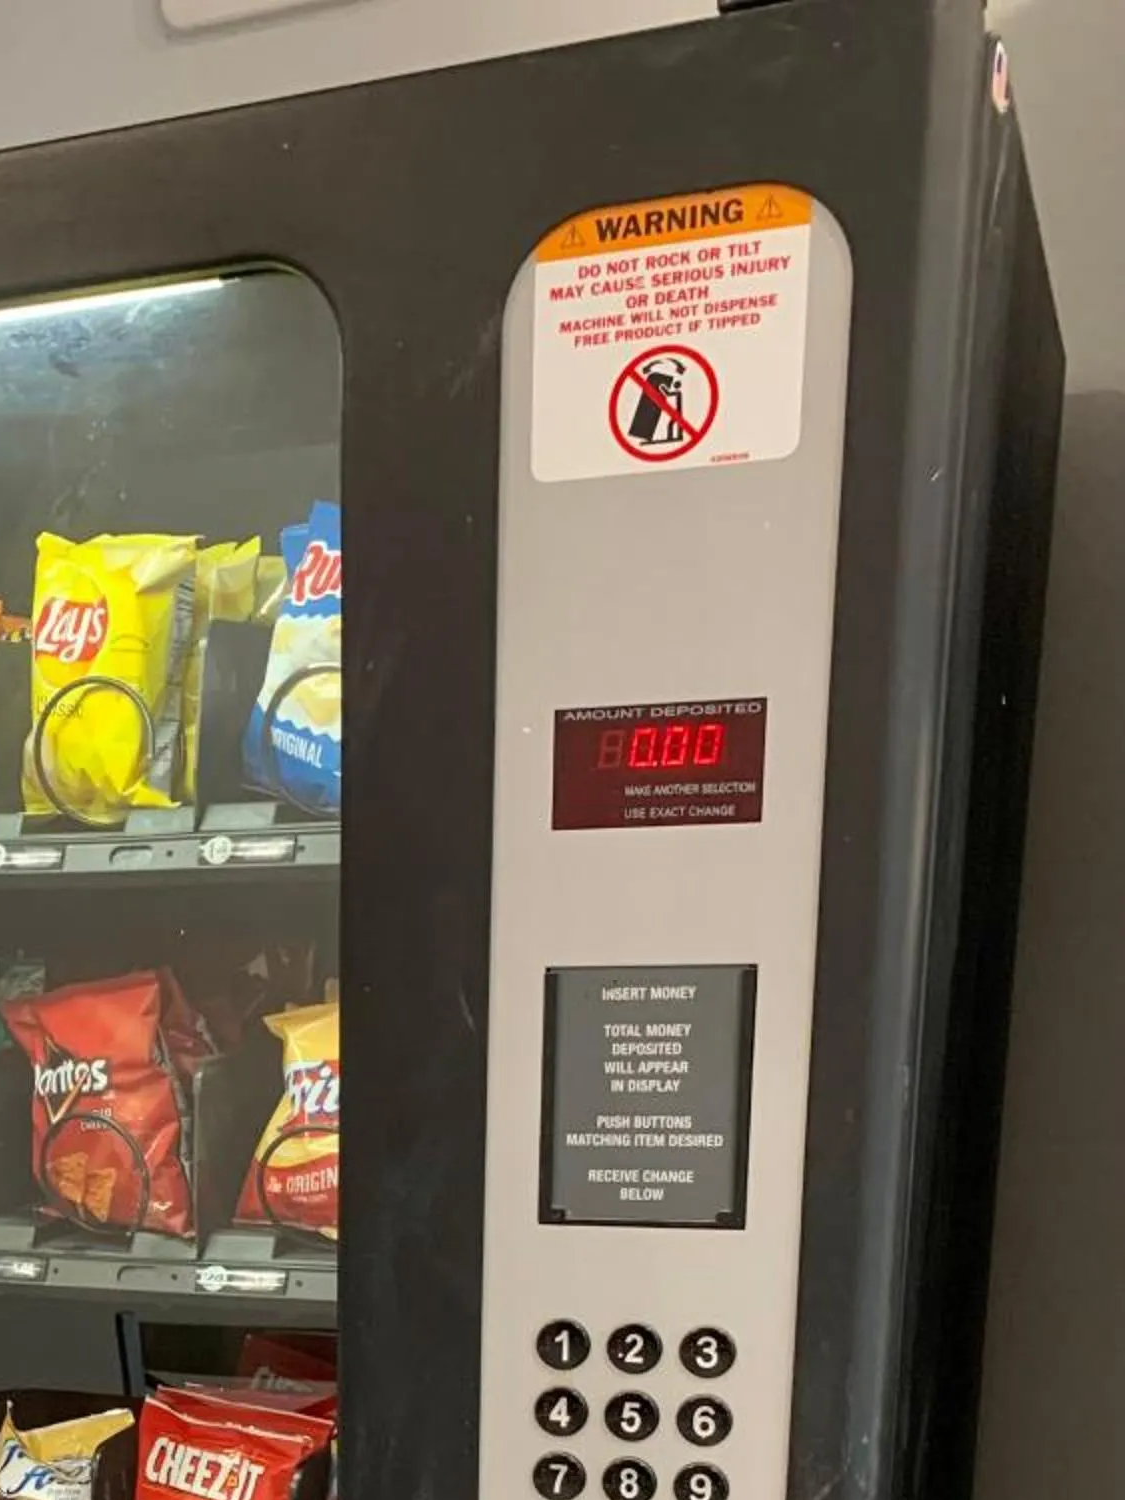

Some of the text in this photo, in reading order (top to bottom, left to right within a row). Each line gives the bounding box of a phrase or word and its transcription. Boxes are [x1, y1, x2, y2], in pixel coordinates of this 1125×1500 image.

[596, 200, 744, 243] WARNING
[578, 241, 762, 280] DO NOT ROCK OR TILT
[549, 256, 792, 302] MAY CAUSE SERIOUS INJURY
[625, 286, 709, 309] OR DEATH
[559, 293, 779, 334] MACHINE WILL NOT DISPENSE
[573, 312, 761, 348] FREE PRODUCT IF TIPPED
[563, 703, 762, 721] AMOUNT DEPOSITED
[624, 781, 756, 797] MAKE ANOTHER SELECTION
[625, 804, 736, 819] USE EXACT CHANGE
[602, 986, 696, 1001] INSERT MONEY
[603, 1024, 692, 1037] TOTAL MONEY
[612, 1043, 682, 1055] DEPOSITED
[604, 1061, 688, 1074] WILL APPEAR
[610, 1080, 681, 1092] IN DISPLAY
[596, 1115, 692, 1129] PUSH BUTTONS
[566, 1134, 724, 1147] MATCHING ITEM DESIRED
[588, 1170, 695, 1183] RECEIVE CHANGE
[620, 1188, 664, 1201] BELOW
[554, 1330, 569, 1362] 1
[624, 1333, 645, 1364] 2
[695, 1336, 718, 1369] 3
[549, 1396, 571, 1428] 4
[620, 1401, 642, 1433] 5
[692, 1405, 716, 1438] 6
[549, 1463, 569, 1495] 7
[619, 1467, 639, 1499] 8
